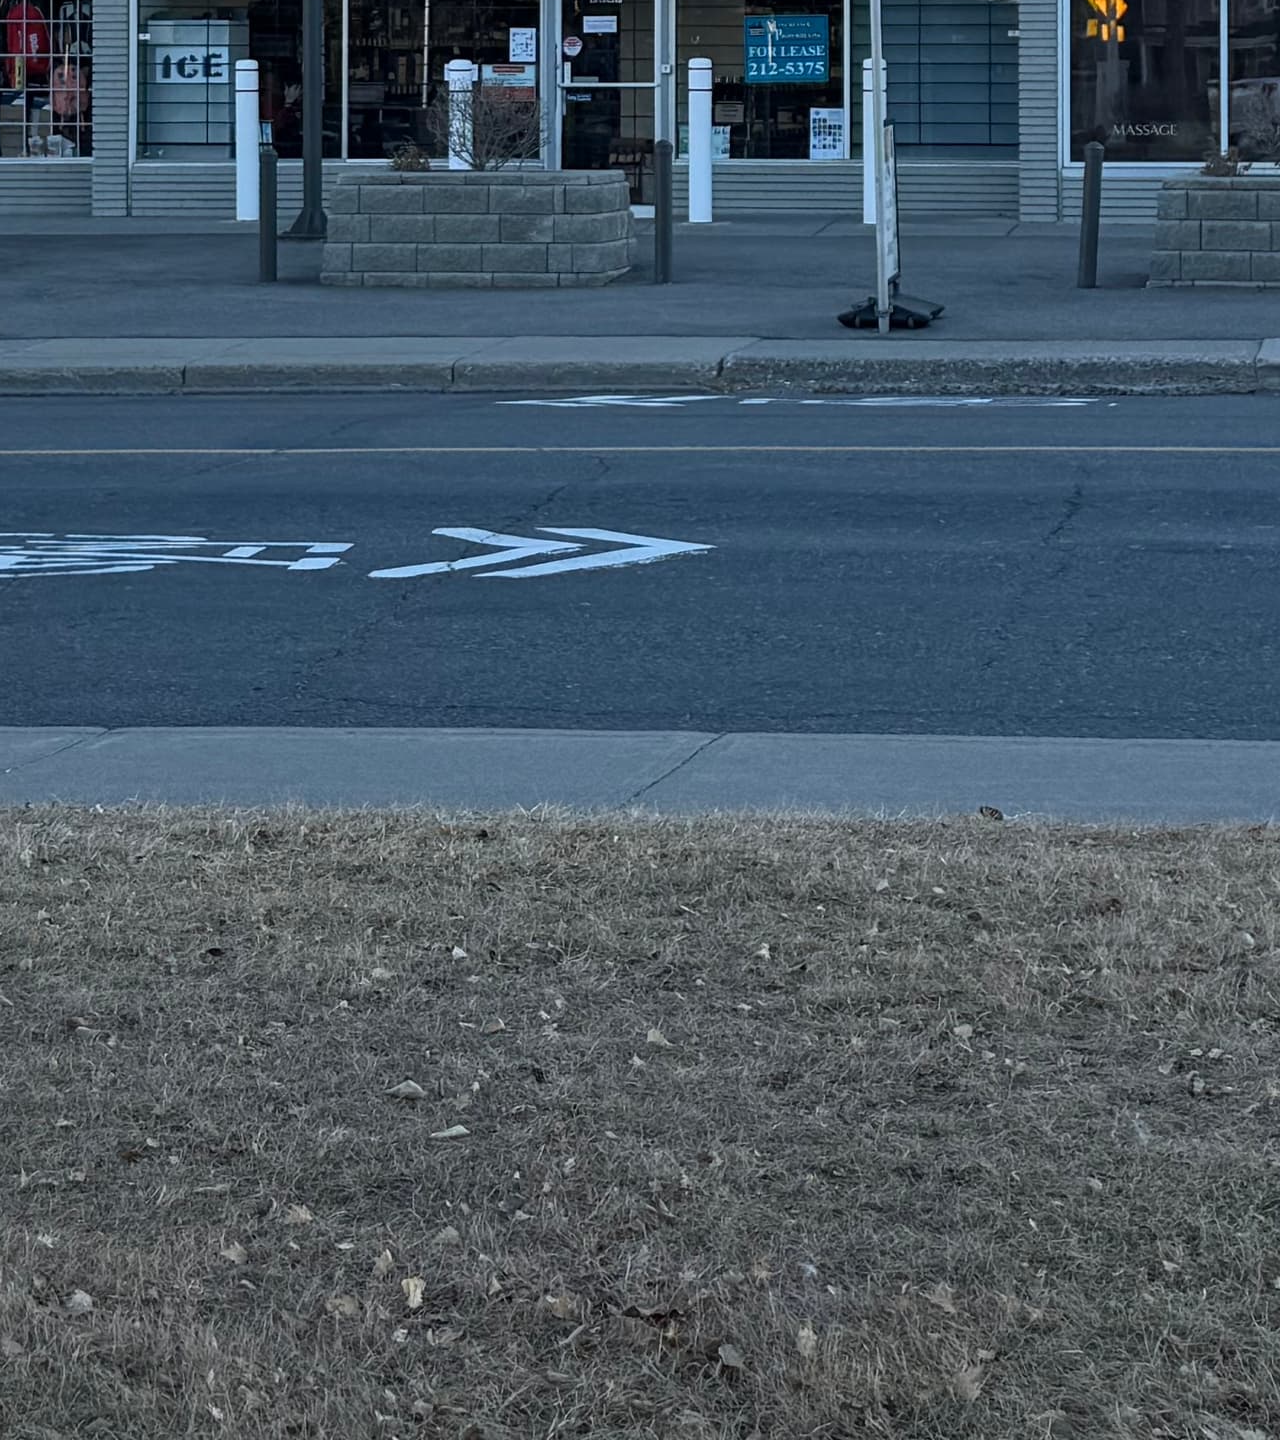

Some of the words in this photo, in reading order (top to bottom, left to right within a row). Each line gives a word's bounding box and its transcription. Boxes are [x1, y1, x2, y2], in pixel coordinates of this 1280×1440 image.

[748, 46, 776, 58] FOR
[781, 45, 825, 57] LEASE
[161, 52, 223, 79] ICE
[748, 61, 825, 75] 212-5375
[1112, 124, 1177, 136] MASSAGE
